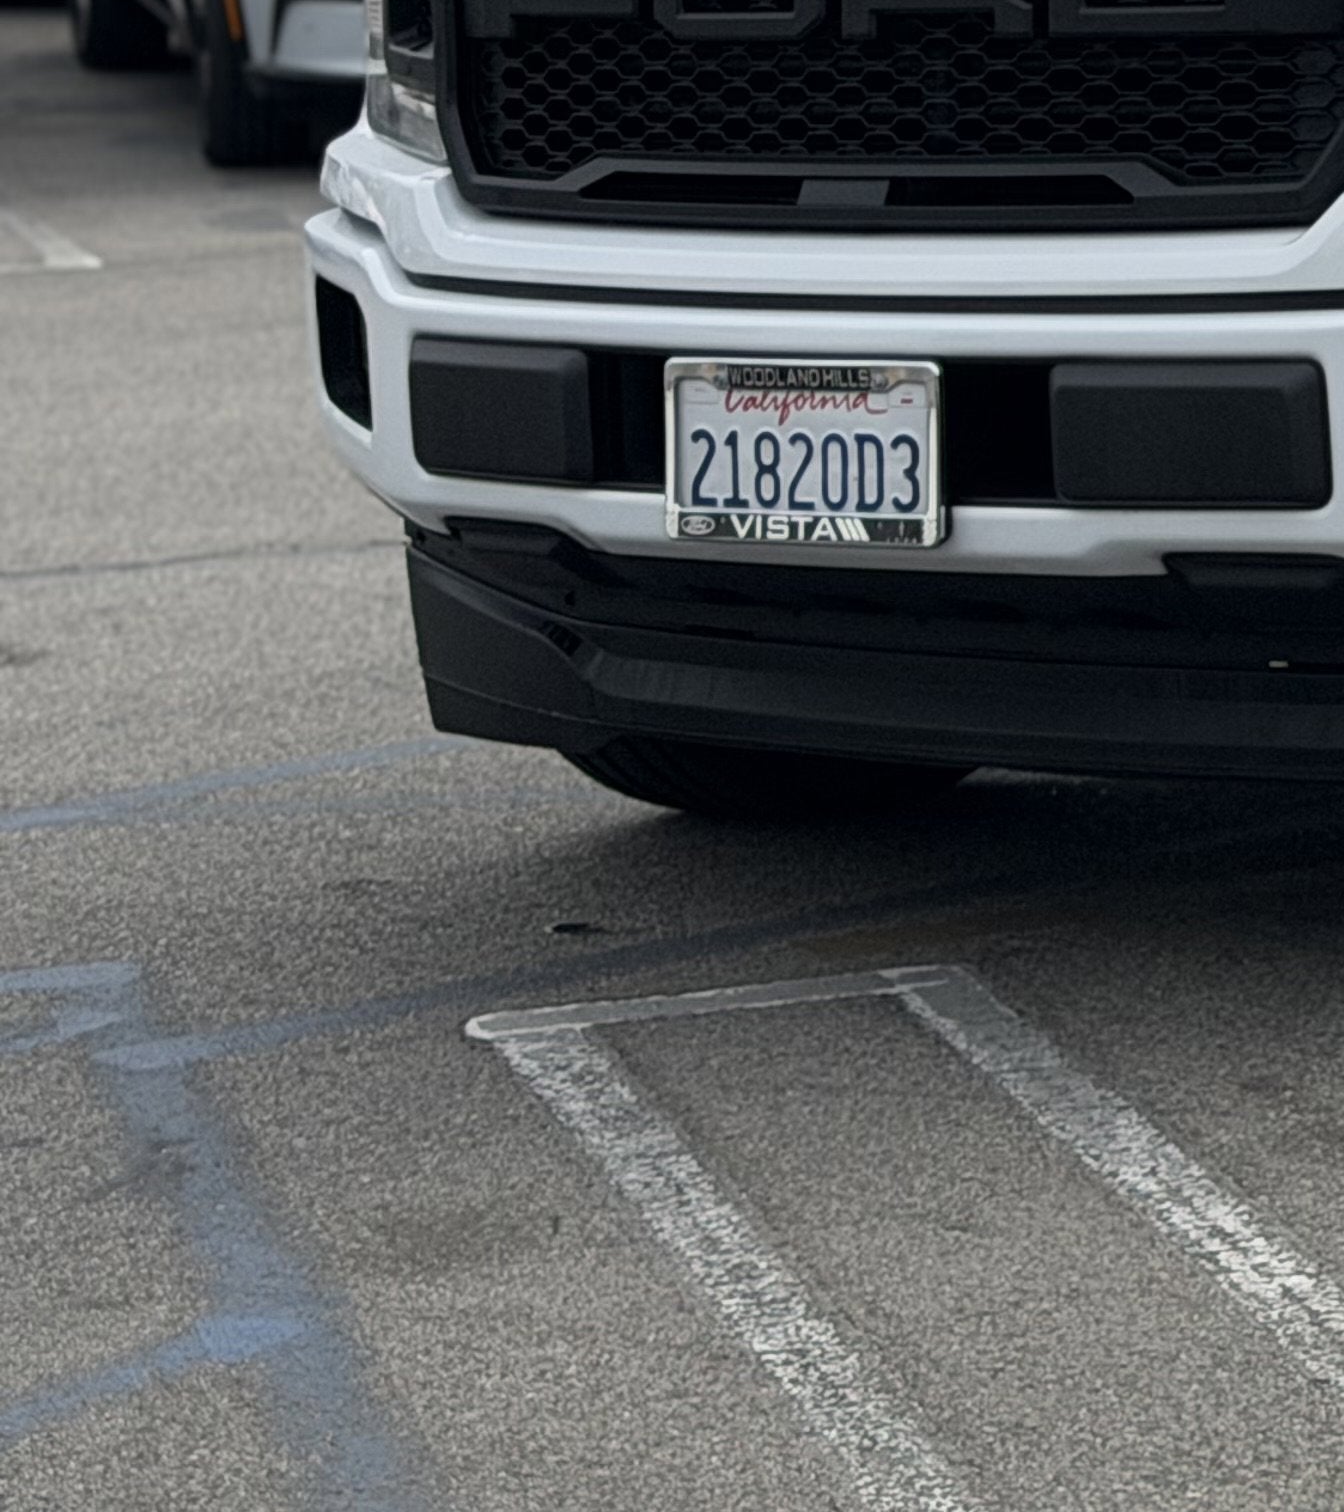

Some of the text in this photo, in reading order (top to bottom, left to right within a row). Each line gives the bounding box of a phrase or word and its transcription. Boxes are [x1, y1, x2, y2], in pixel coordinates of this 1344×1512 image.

[724, 390, 888, 426] California
[690, 428, 921, 514] 21820D3
[729, 514, 838, 541] VISTA
